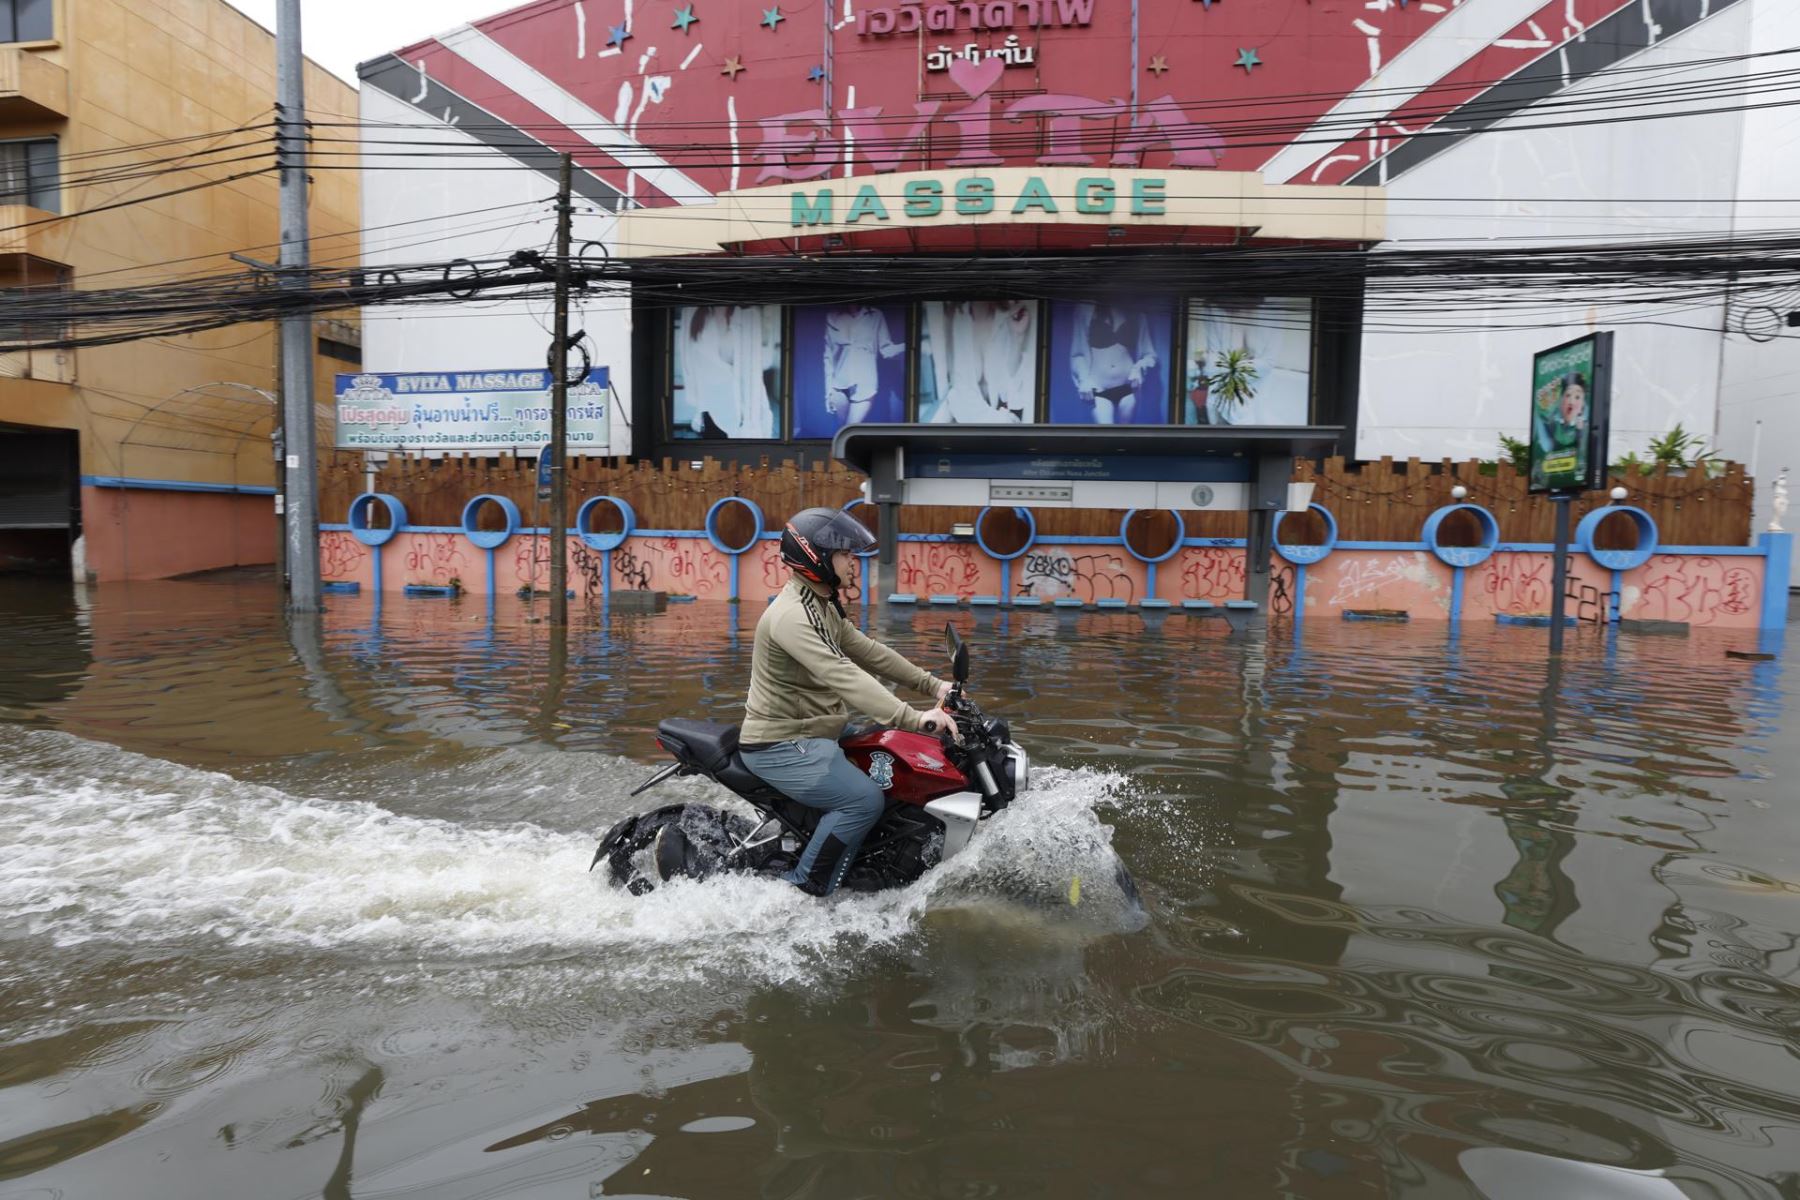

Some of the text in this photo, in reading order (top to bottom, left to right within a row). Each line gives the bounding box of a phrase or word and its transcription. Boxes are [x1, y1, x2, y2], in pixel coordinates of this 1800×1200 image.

[752, 94, 1227, 184] EVITA
[790, 176, 1167, 227] MASSAGE
[396, 375, 452, 392] EVITA
[455, 371, 545, 391] MASSAGE
